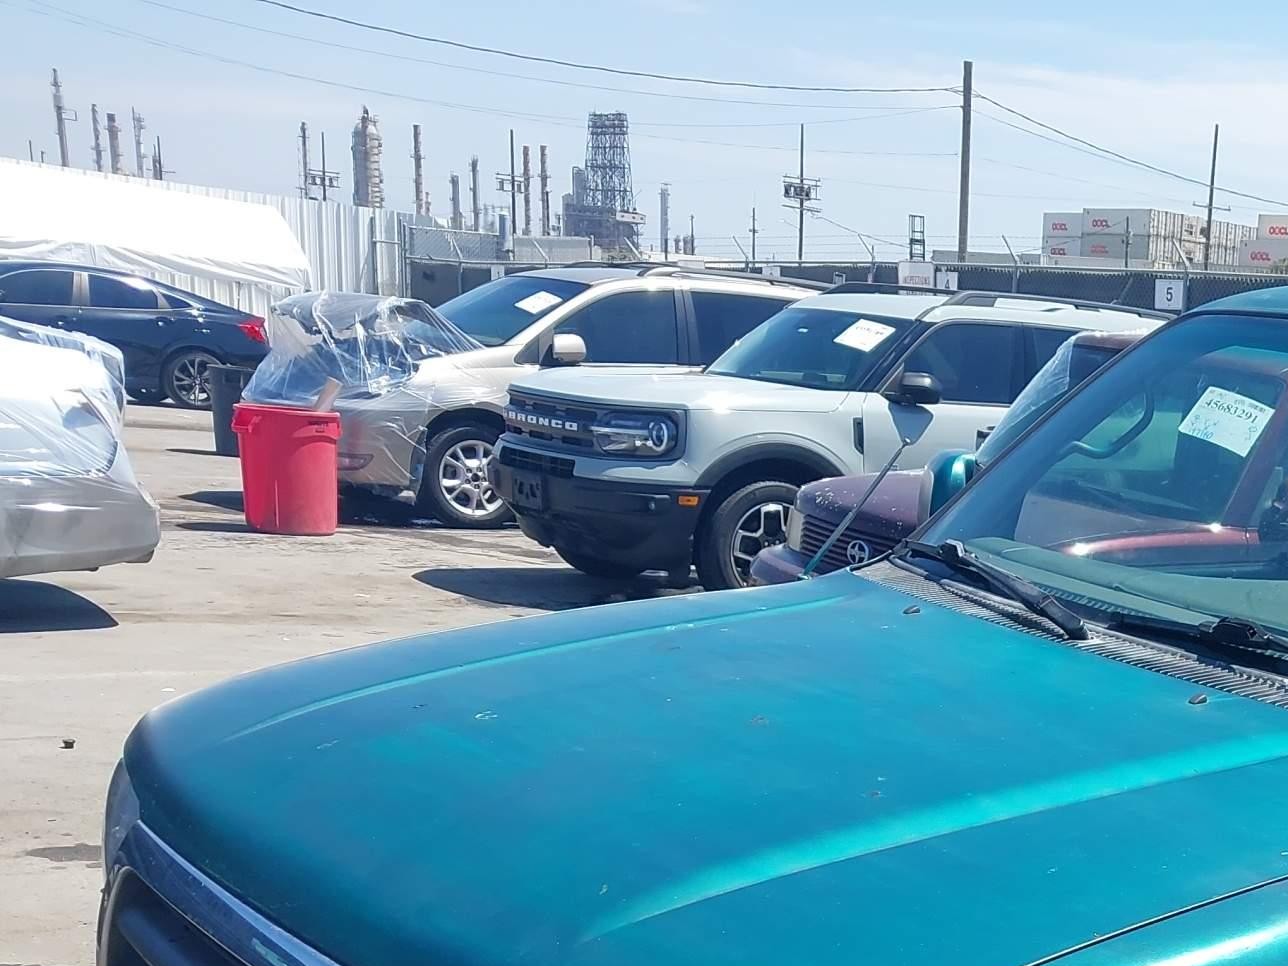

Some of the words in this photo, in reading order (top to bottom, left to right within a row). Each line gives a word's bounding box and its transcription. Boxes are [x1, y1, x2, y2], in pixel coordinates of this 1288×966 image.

[1250, 251, 1271, 261] OOCL
[1166, 286, 1174, 302] 5
[508, 410, 578, 431] BRONCO
[1205, 399, 1259, 424] 45683291
